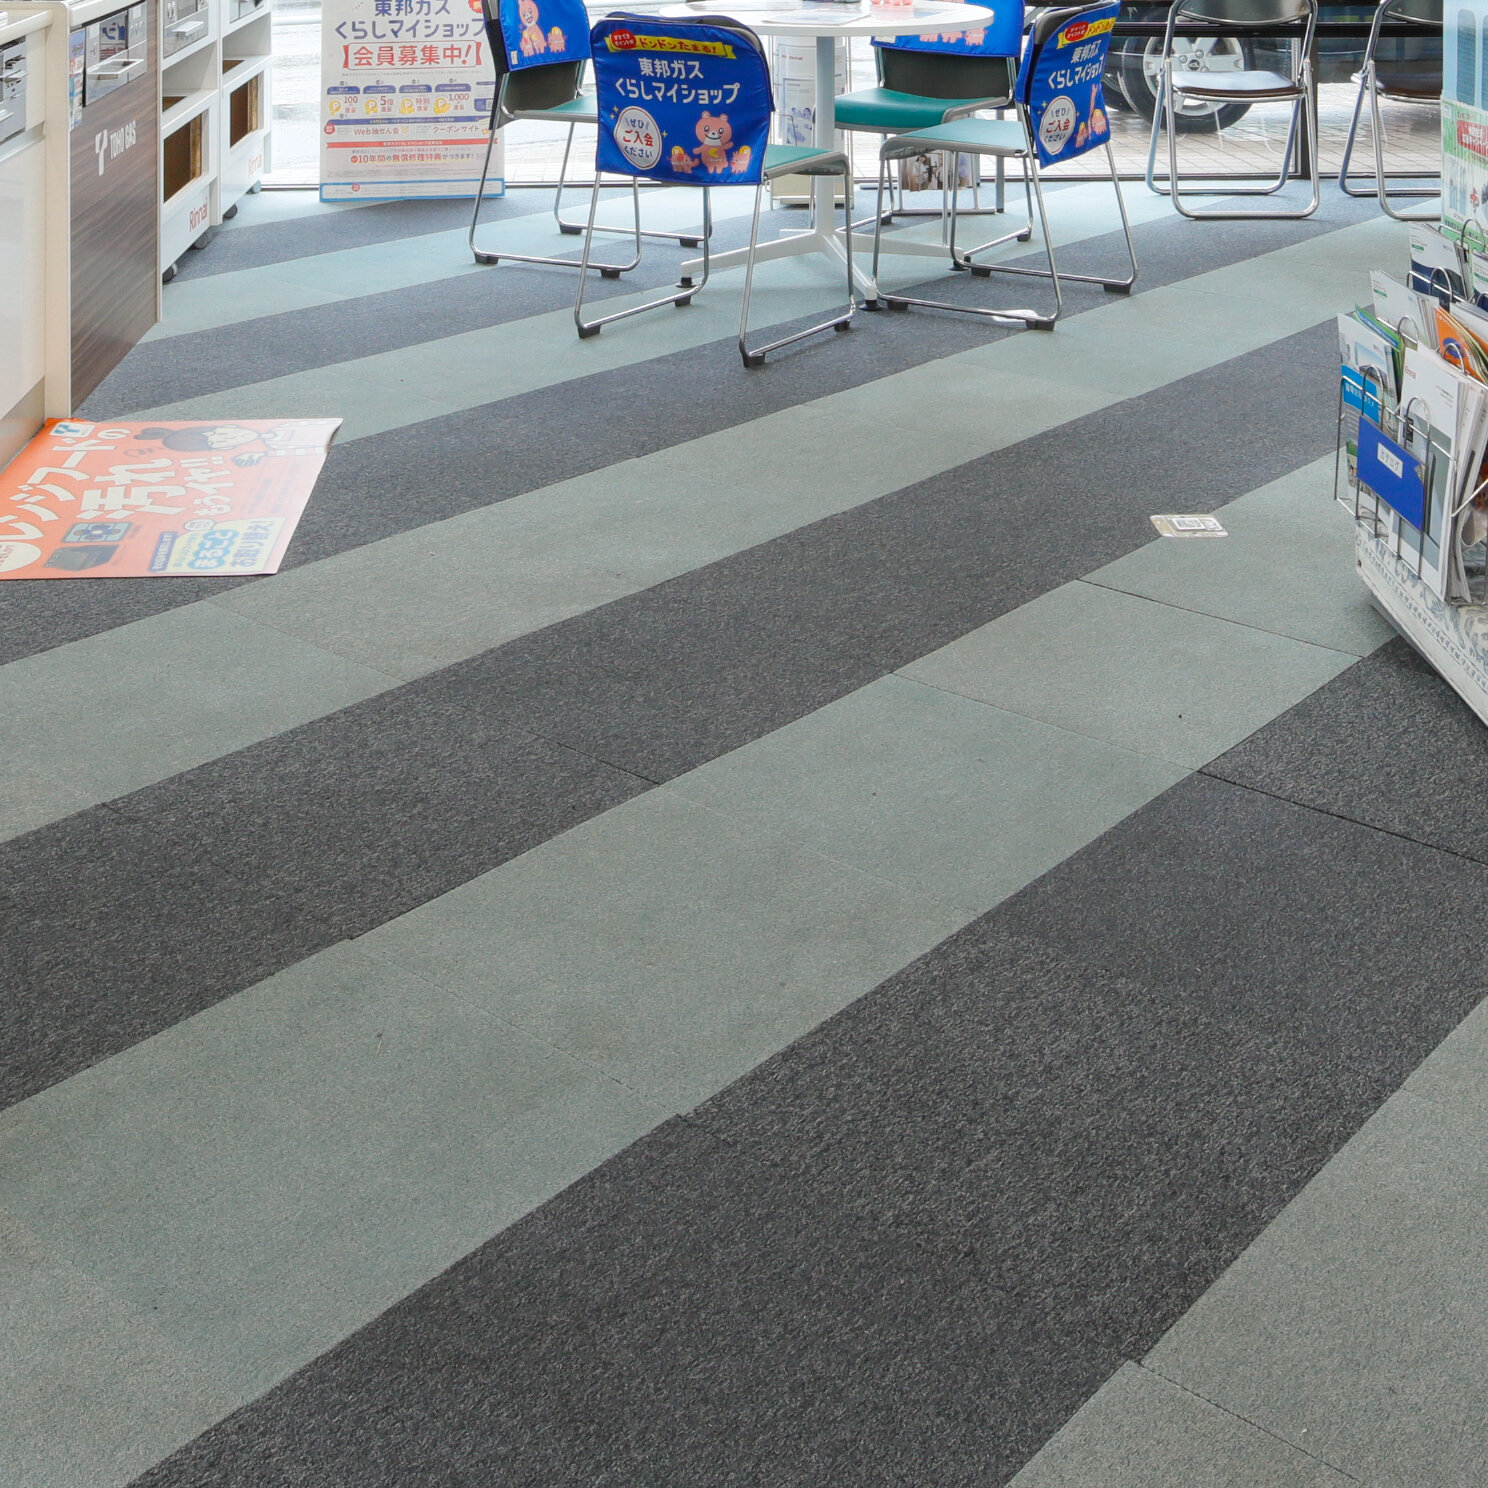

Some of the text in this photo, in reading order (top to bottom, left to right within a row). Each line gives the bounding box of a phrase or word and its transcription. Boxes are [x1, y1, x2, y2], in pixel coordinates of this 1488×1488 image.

[353, 44, 473, 67] 会員募集中!
[637, 38, 718, 55] ドンドンたまる!
[638, 57, 704, 80] 東邦ガス
[614, 77, 741, 105] くらしマイショップ
[1045, 118, 1071, 133] ご入会
[622, 129, 654, 147] ご入会
[623, 144, 654, 159] ください
[75, 458, 194, 520] 汚れ
